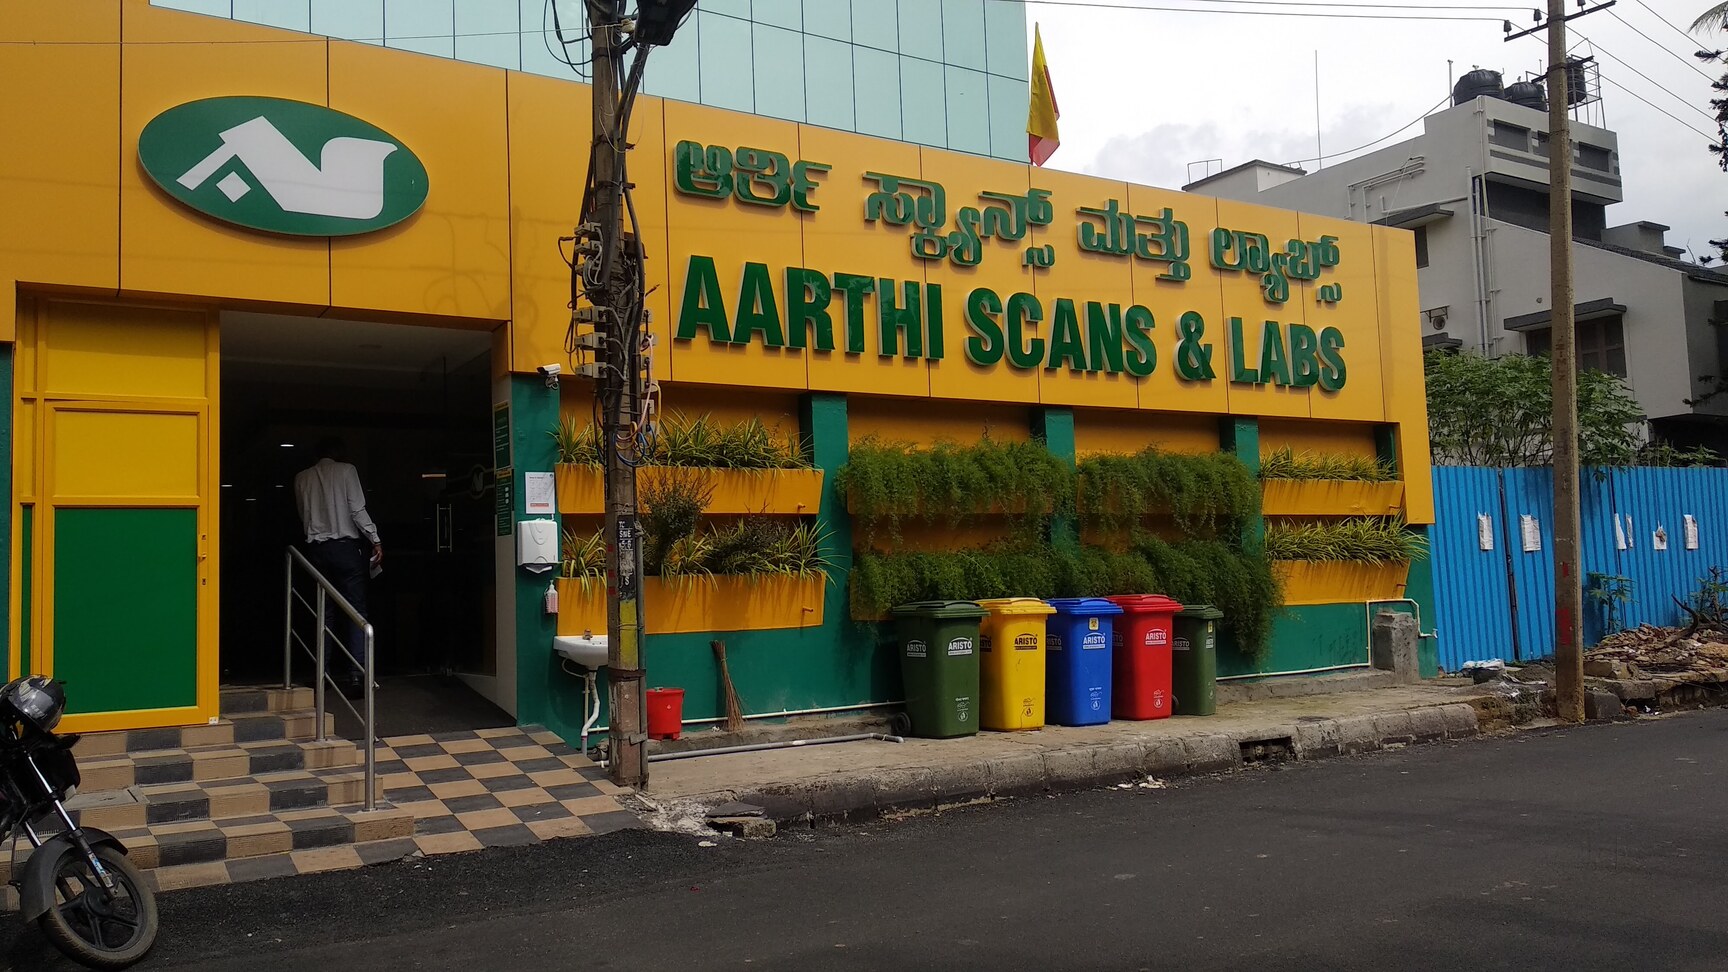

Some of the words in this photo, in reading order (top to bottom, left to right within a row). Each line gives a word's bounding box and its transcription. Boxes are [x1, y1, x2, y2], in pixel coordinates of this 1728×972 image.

[1076, 199, 1191, 281] ಮತ್ತು
[674, 255, 944, 360] AARTHI
[963, 287, 1157, 377] SCANS
[1173, 310, 1217, 381] &
[1226, 316, 1347, 392] LABS
[1014, 637, 1038, 646] ARISTO
[1082, 635, 1106, 645] ARISTO
[1145, 632, 1167, 641] ARISTO
[906, 643, 927, 653] ARISTO
[948, 641, 973, 651] ARISTO
